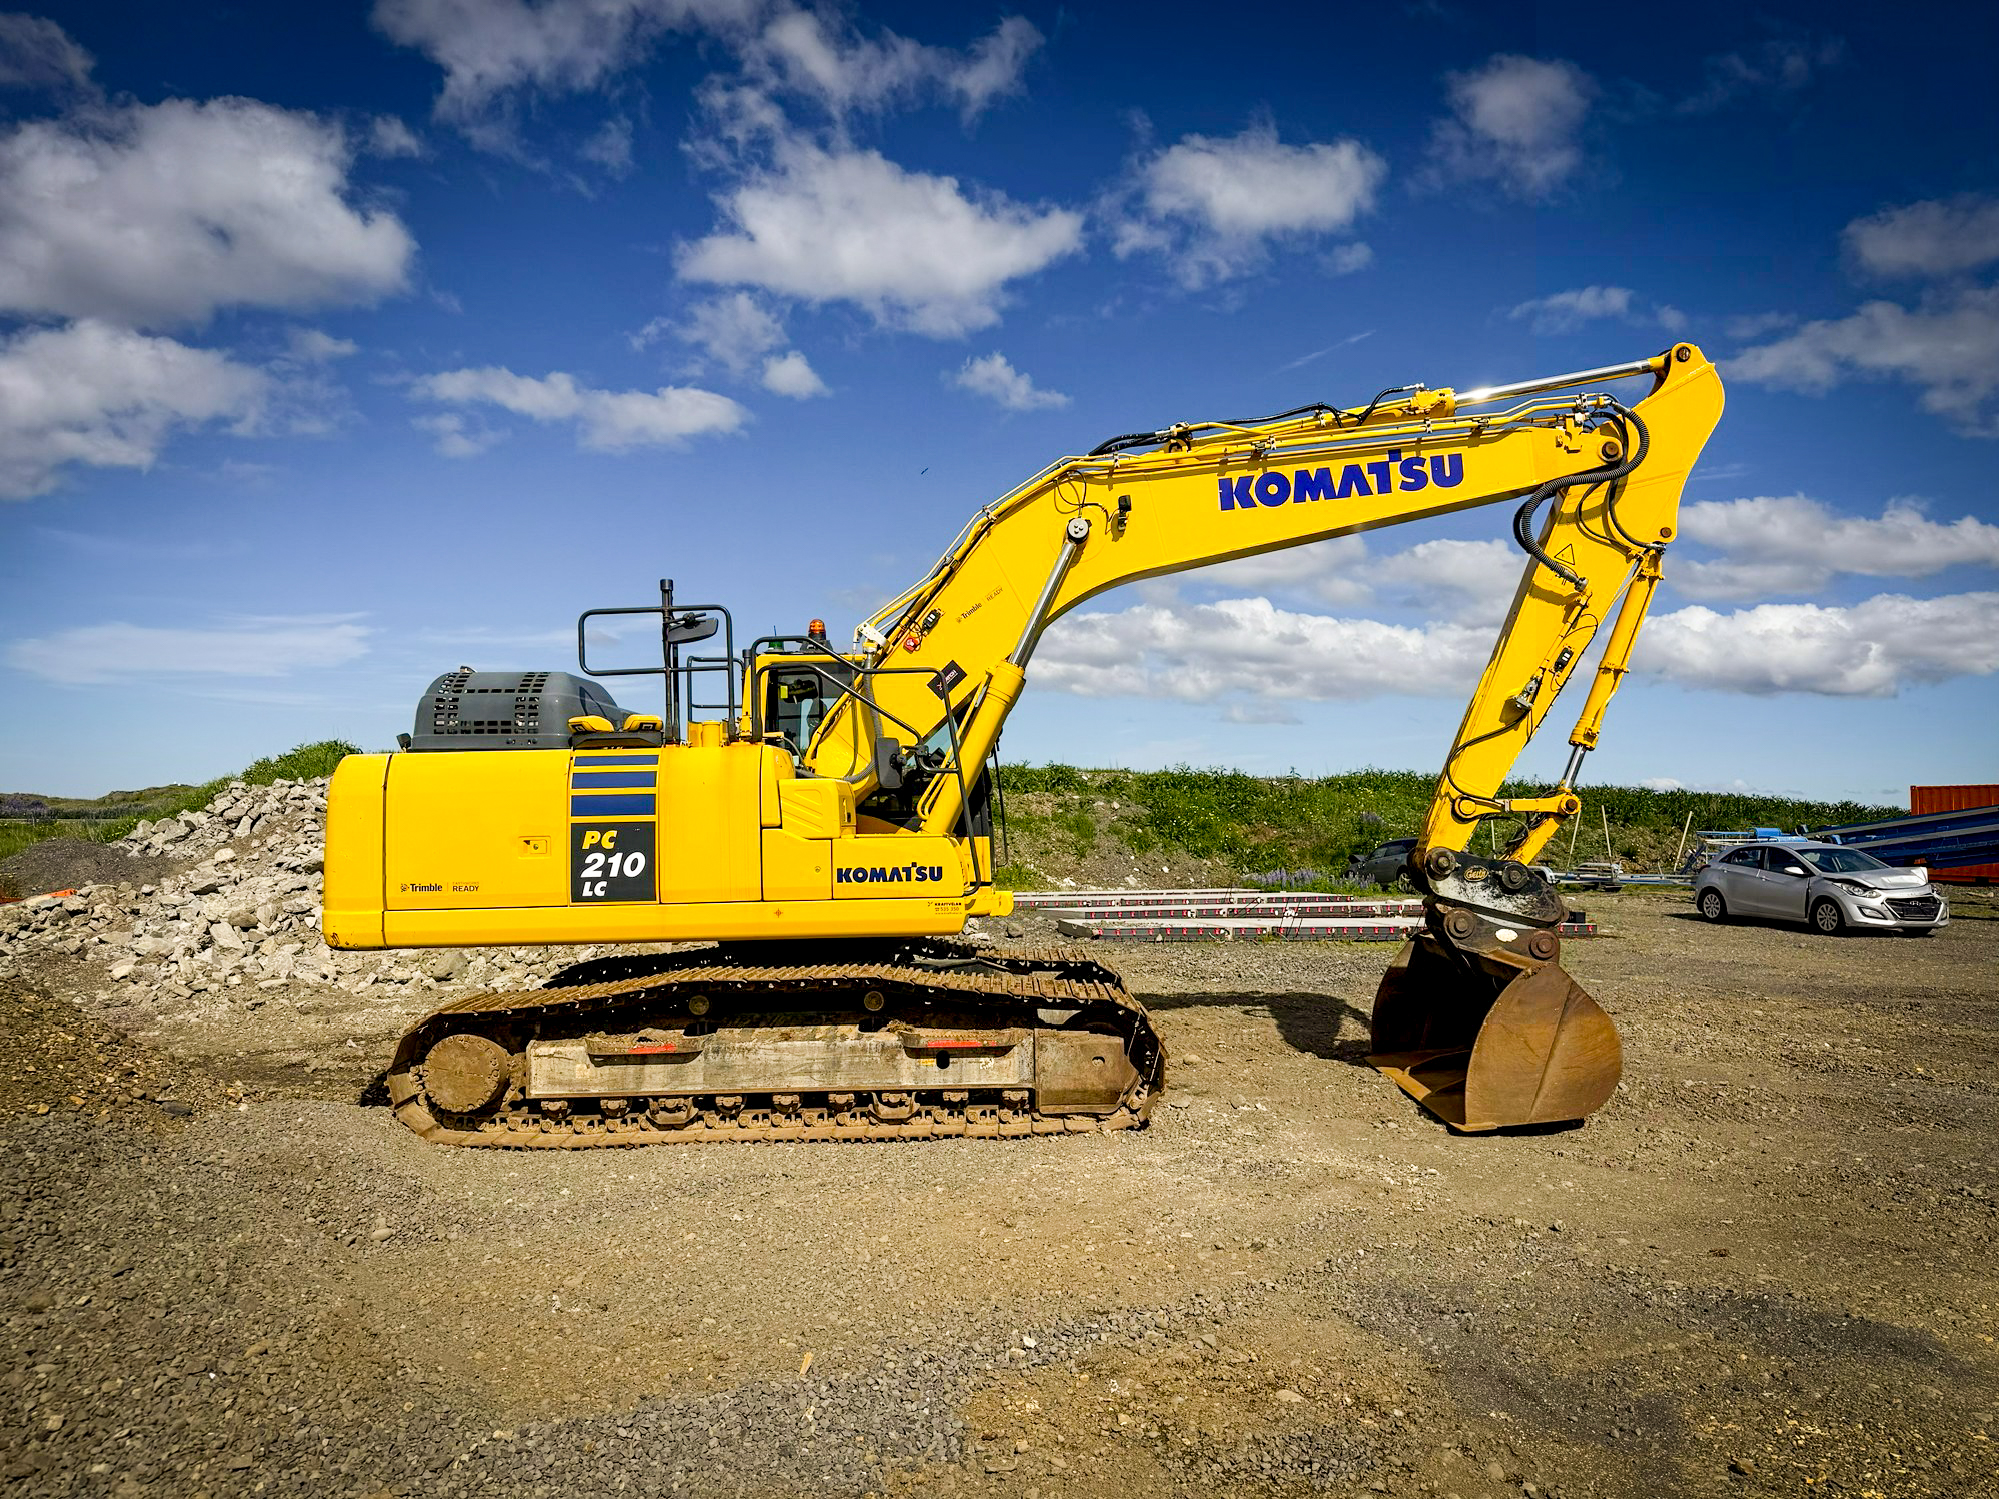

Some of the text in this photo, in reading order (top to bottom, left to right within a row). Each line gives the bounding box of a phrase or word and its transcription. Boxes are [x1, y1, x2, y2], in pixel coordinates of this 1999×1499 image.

[1217, 449, 1464, 512] KOMATSU
[961, 602, 982, 619] Trimble
[581, 830, 618, 850] PC
[580, 851, 646, 878] 210
[836, 861, 943, 883] KOMATSU
[410, 883, 443, 892] Trimble
[581, 881, 608, 897] LC
